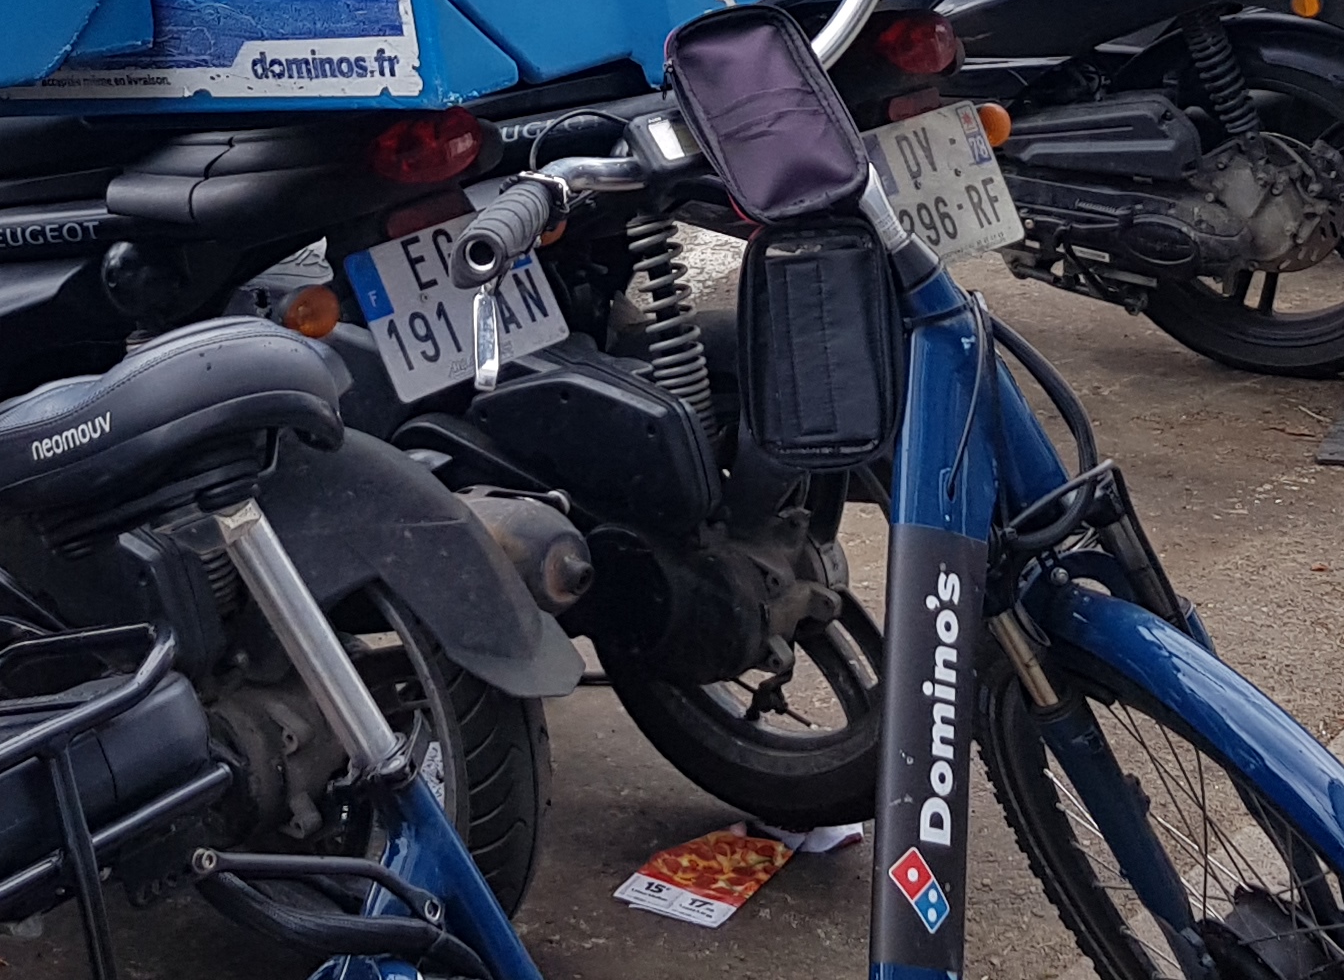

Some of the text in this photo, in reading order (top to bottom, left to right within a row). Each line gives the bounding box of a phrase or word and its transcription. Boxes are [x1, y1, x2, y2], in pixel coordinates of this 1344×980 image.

[251, 47, 399, 81] dominos.fr
[32, 412, 111, 461] neomouv
[920, 570, 962, 847] Domino's
